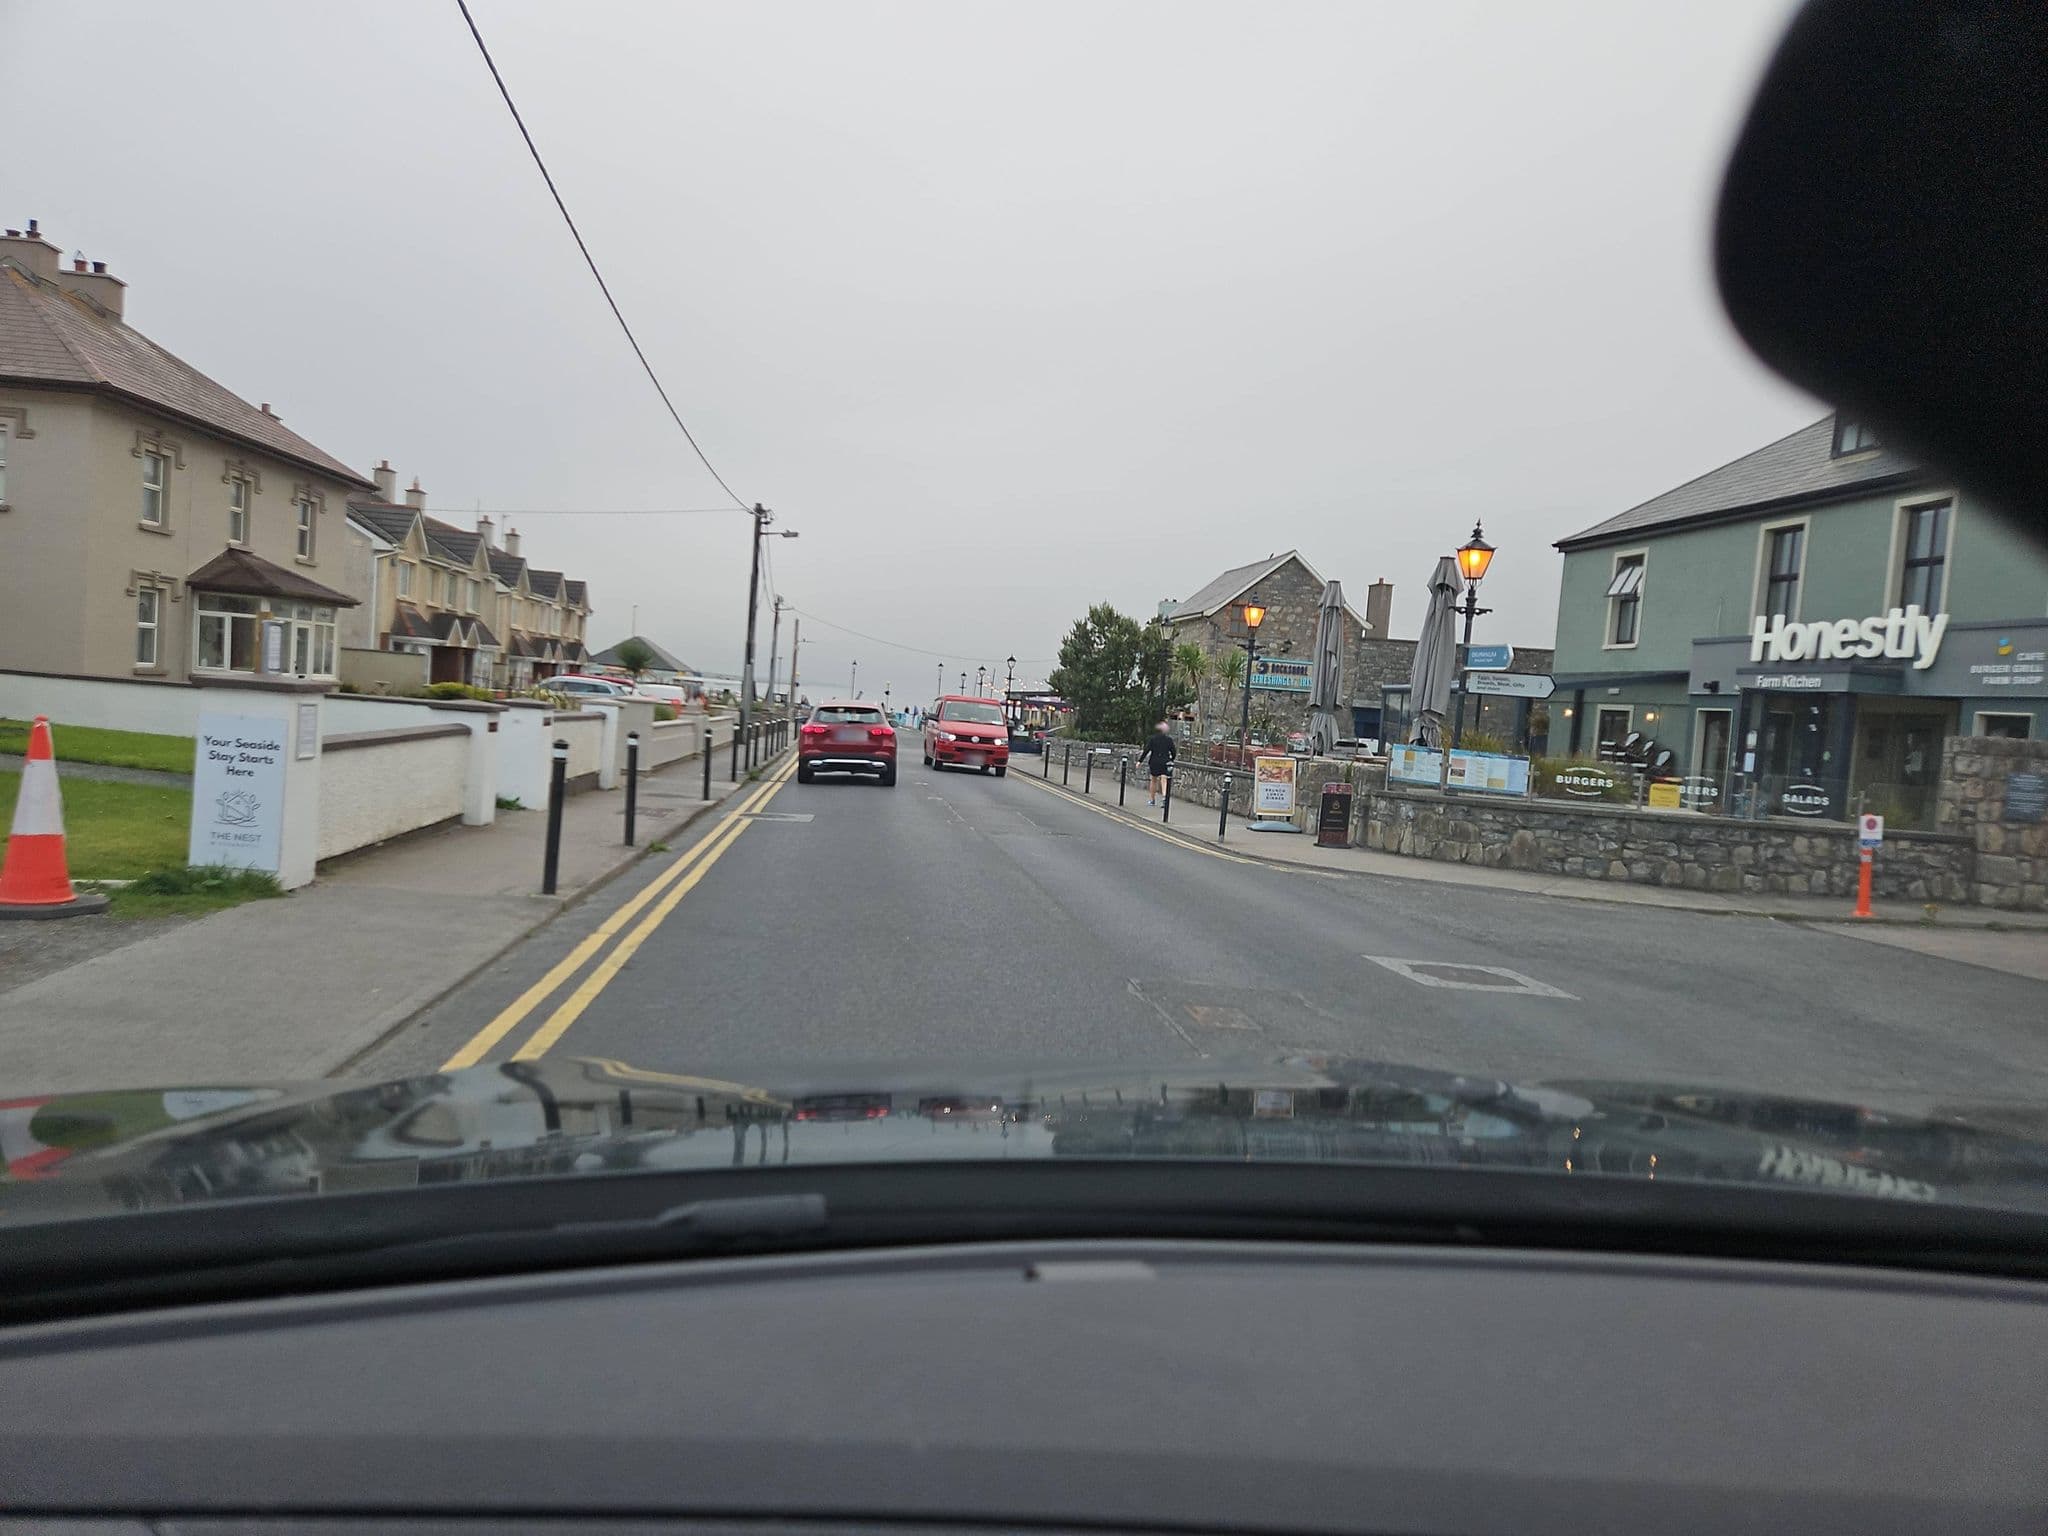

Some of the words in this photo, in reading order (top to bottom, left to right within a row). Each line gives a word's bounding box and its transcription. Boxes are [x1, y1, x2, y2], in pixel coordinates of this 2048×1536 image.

[1750, 604, 1949, 669] Honestly
[1970, 665, 2010, 674] BURGER
[2012, 664, 2044, 673] GRILL
[1756, 675, 1781, 687] Farm
[1782, 674, 1821, 688] Kitchen
[2012, 675, 2043, 684] SHOP
[204, 735, 232, 747] Your
[235, 738, 281, 751] Seaside
[208, 750, 236, 764] Stay
[238, 752, 274, 765] Starts
[226, 765, 255, 777] Here
[1556, 775, 1614, 788] BURGERS
[1680, 785, 1719, 797] BEERS
[1782, 793, 1830, 806] SALADS
[211, 832, 232, 841] THE
[234, 833, 262, 842] NEST
